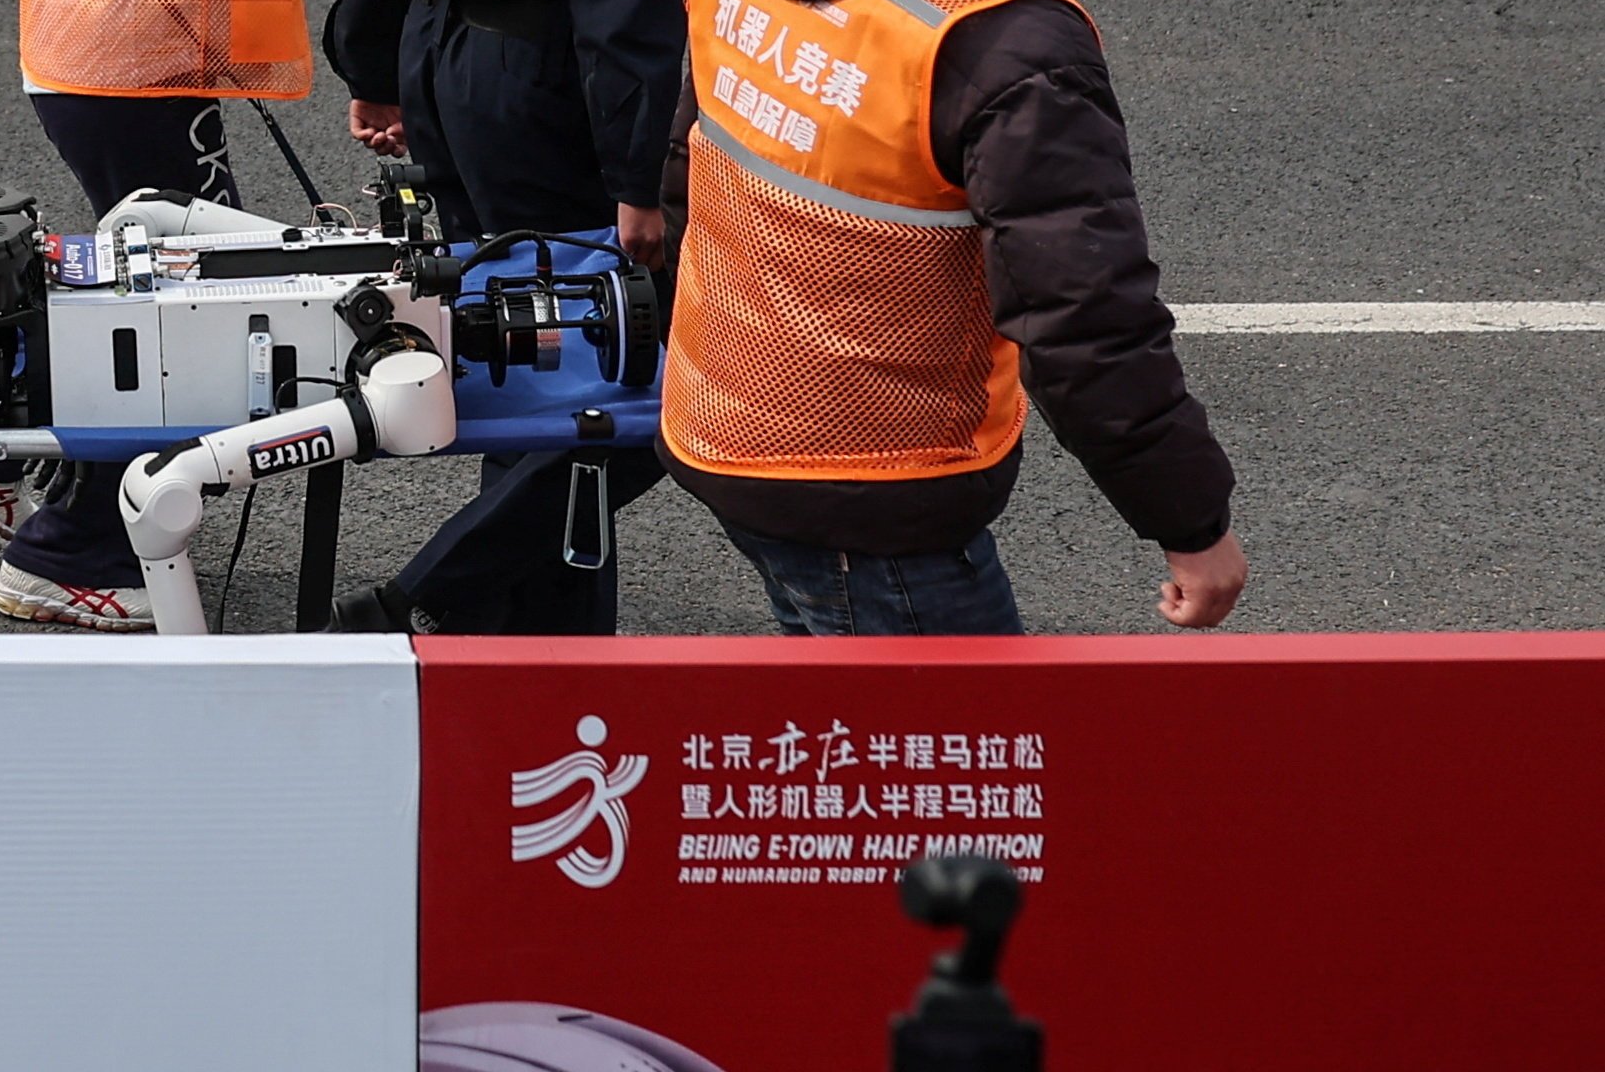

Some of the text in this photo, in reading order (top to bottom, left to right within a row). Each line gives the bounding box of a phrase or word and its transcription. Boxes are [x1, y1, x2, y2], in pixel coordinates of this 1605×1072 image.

[713, 64, 818, 153] 应急保障
[63, 244, 84, 280] Auto-017
[255, 436, 330, 470] Ultra
[682, 719, 1045, 783] 北京亦庄半程马拉松
[681, 784, 1044, 820] 暨人形机器人半程马拉松
[678, 834, 1044, 861] BEIJING E-TOWN HALF MARATHON
[678, 866, 717, 884] AND
[722, 866, 821, 884] HUMANOID
[827, 866, 887, 884] ROBOT
